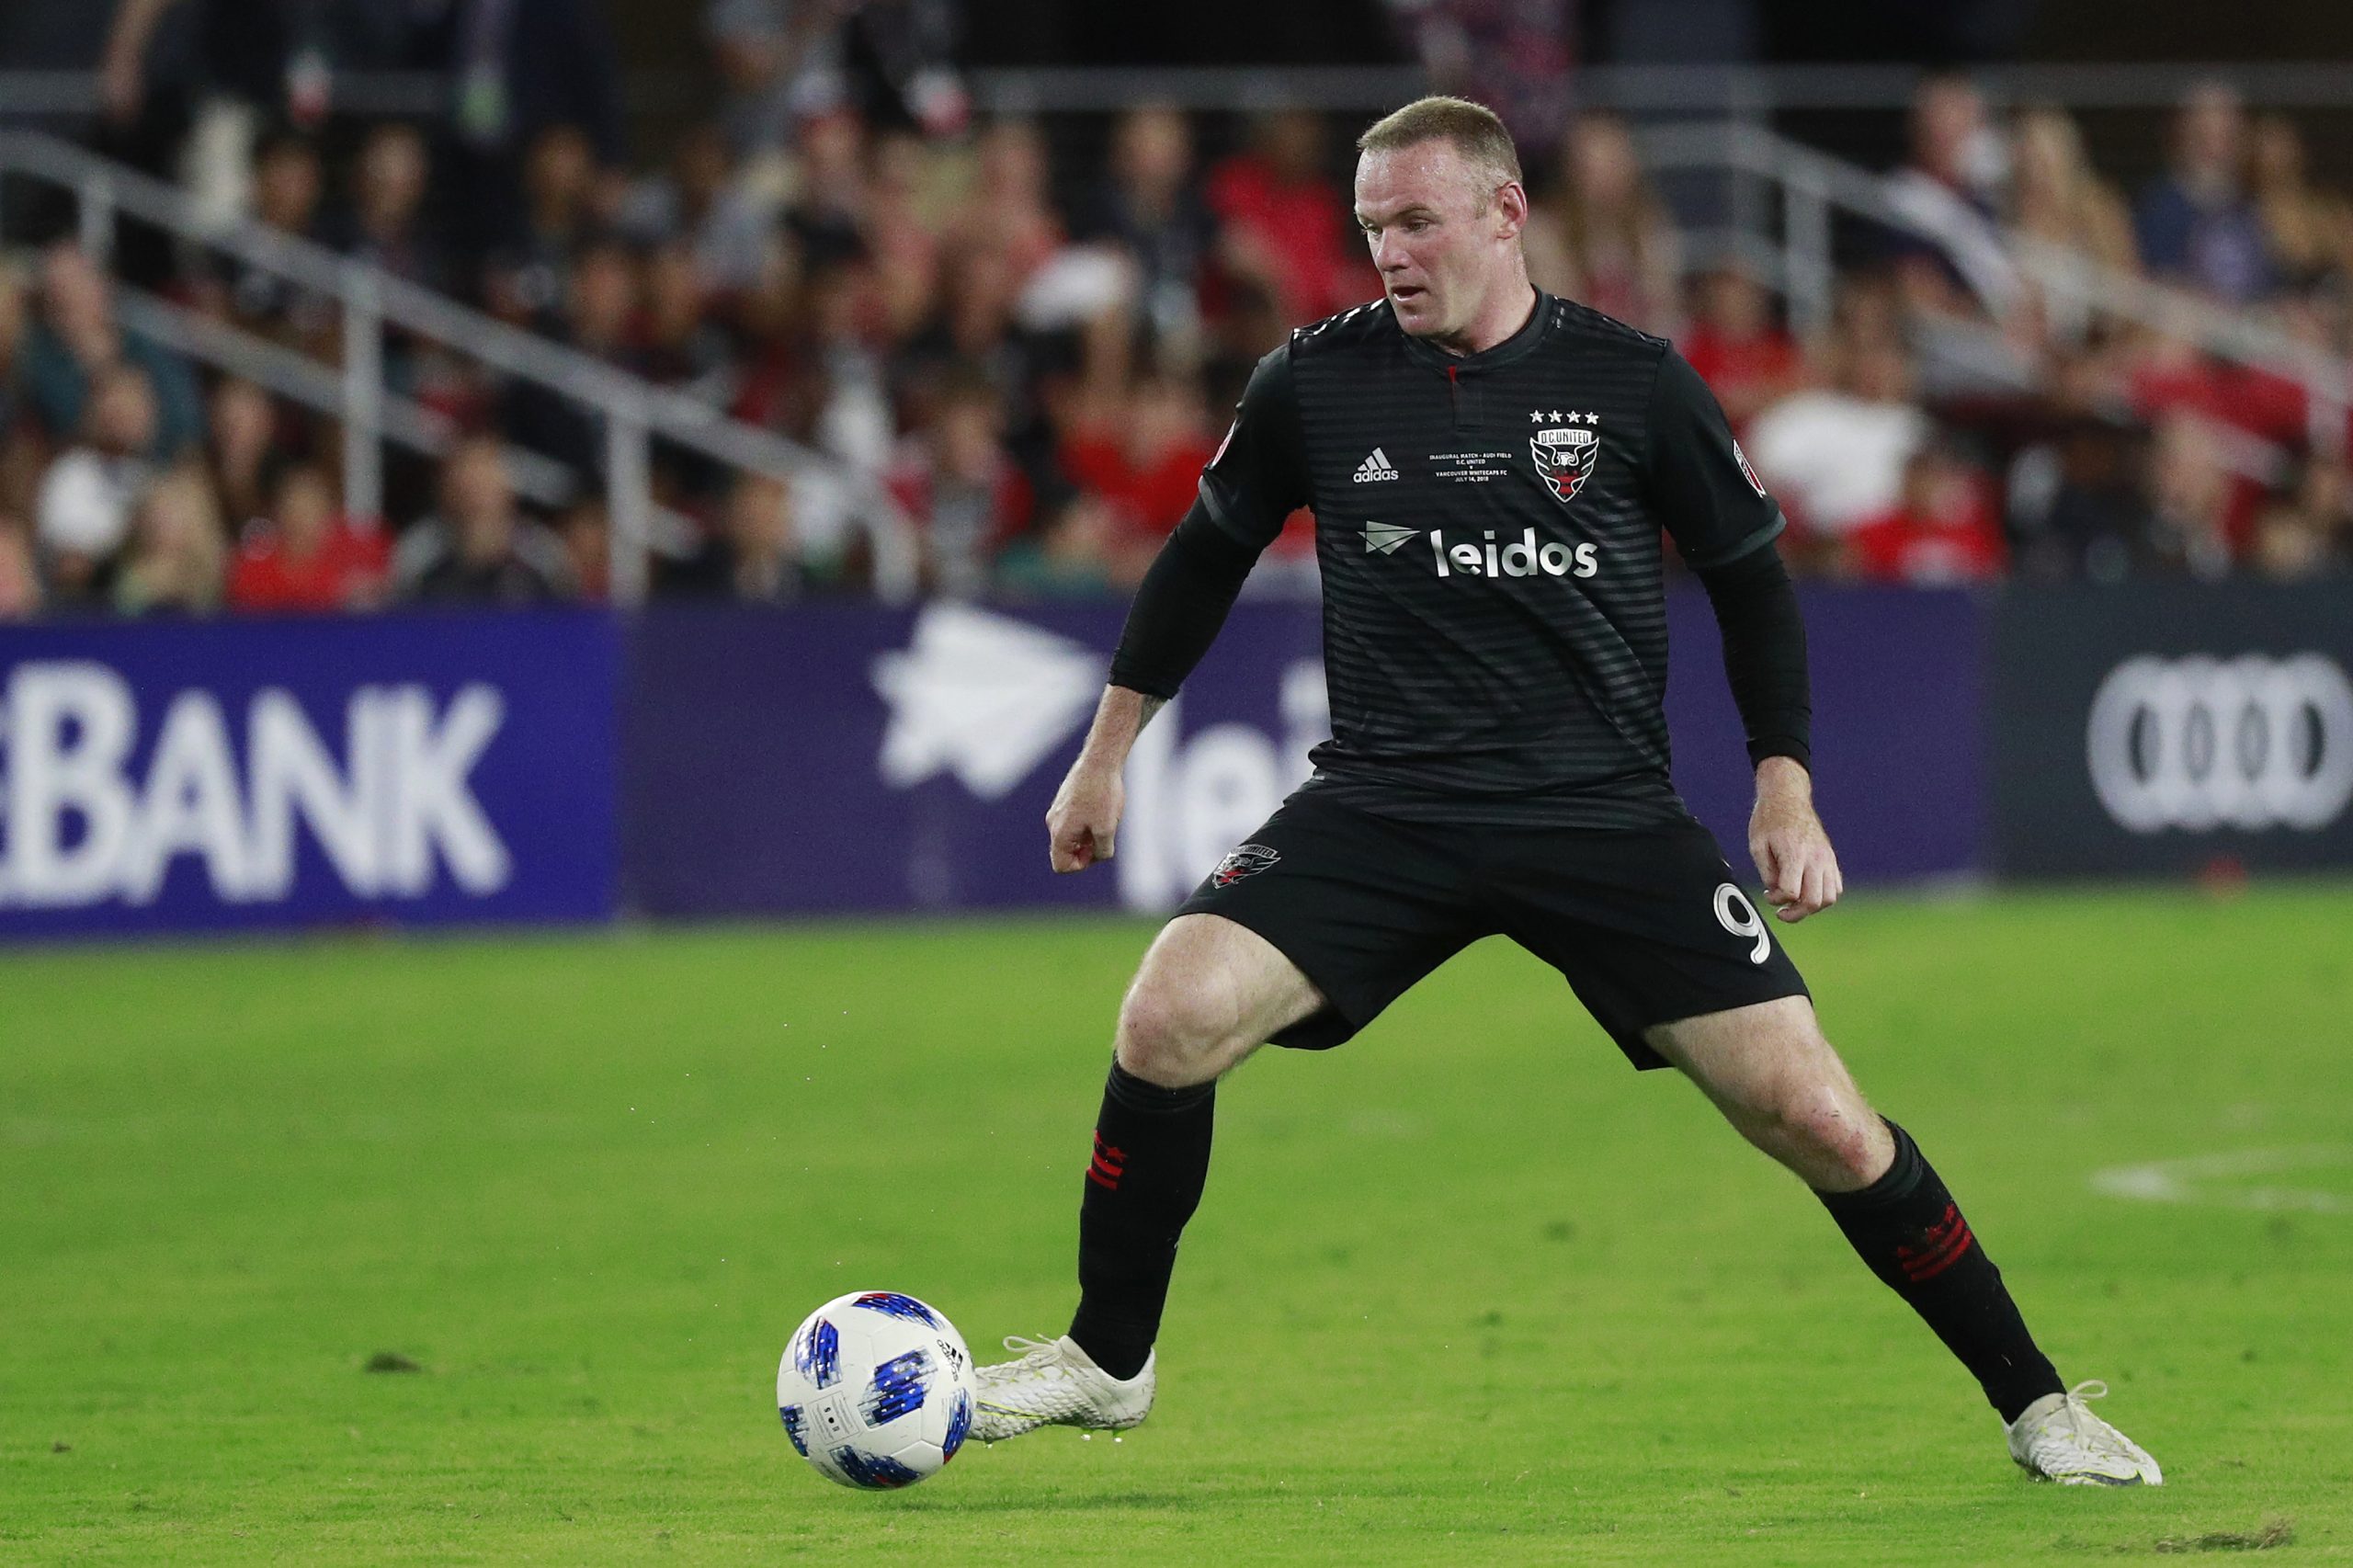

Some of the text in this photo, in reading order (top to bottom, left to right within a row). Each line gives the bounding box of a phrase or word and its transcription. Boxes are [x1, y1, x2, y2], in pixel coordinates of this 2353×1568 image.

[1353, 469, 1399, 483] adidas
[1429, 527, 1598, 578] leidos
[0, 658, 515, 905] BANK
[1713, 882, 1771, 965] 9
[937, 1339, 959, 1381] adidas
